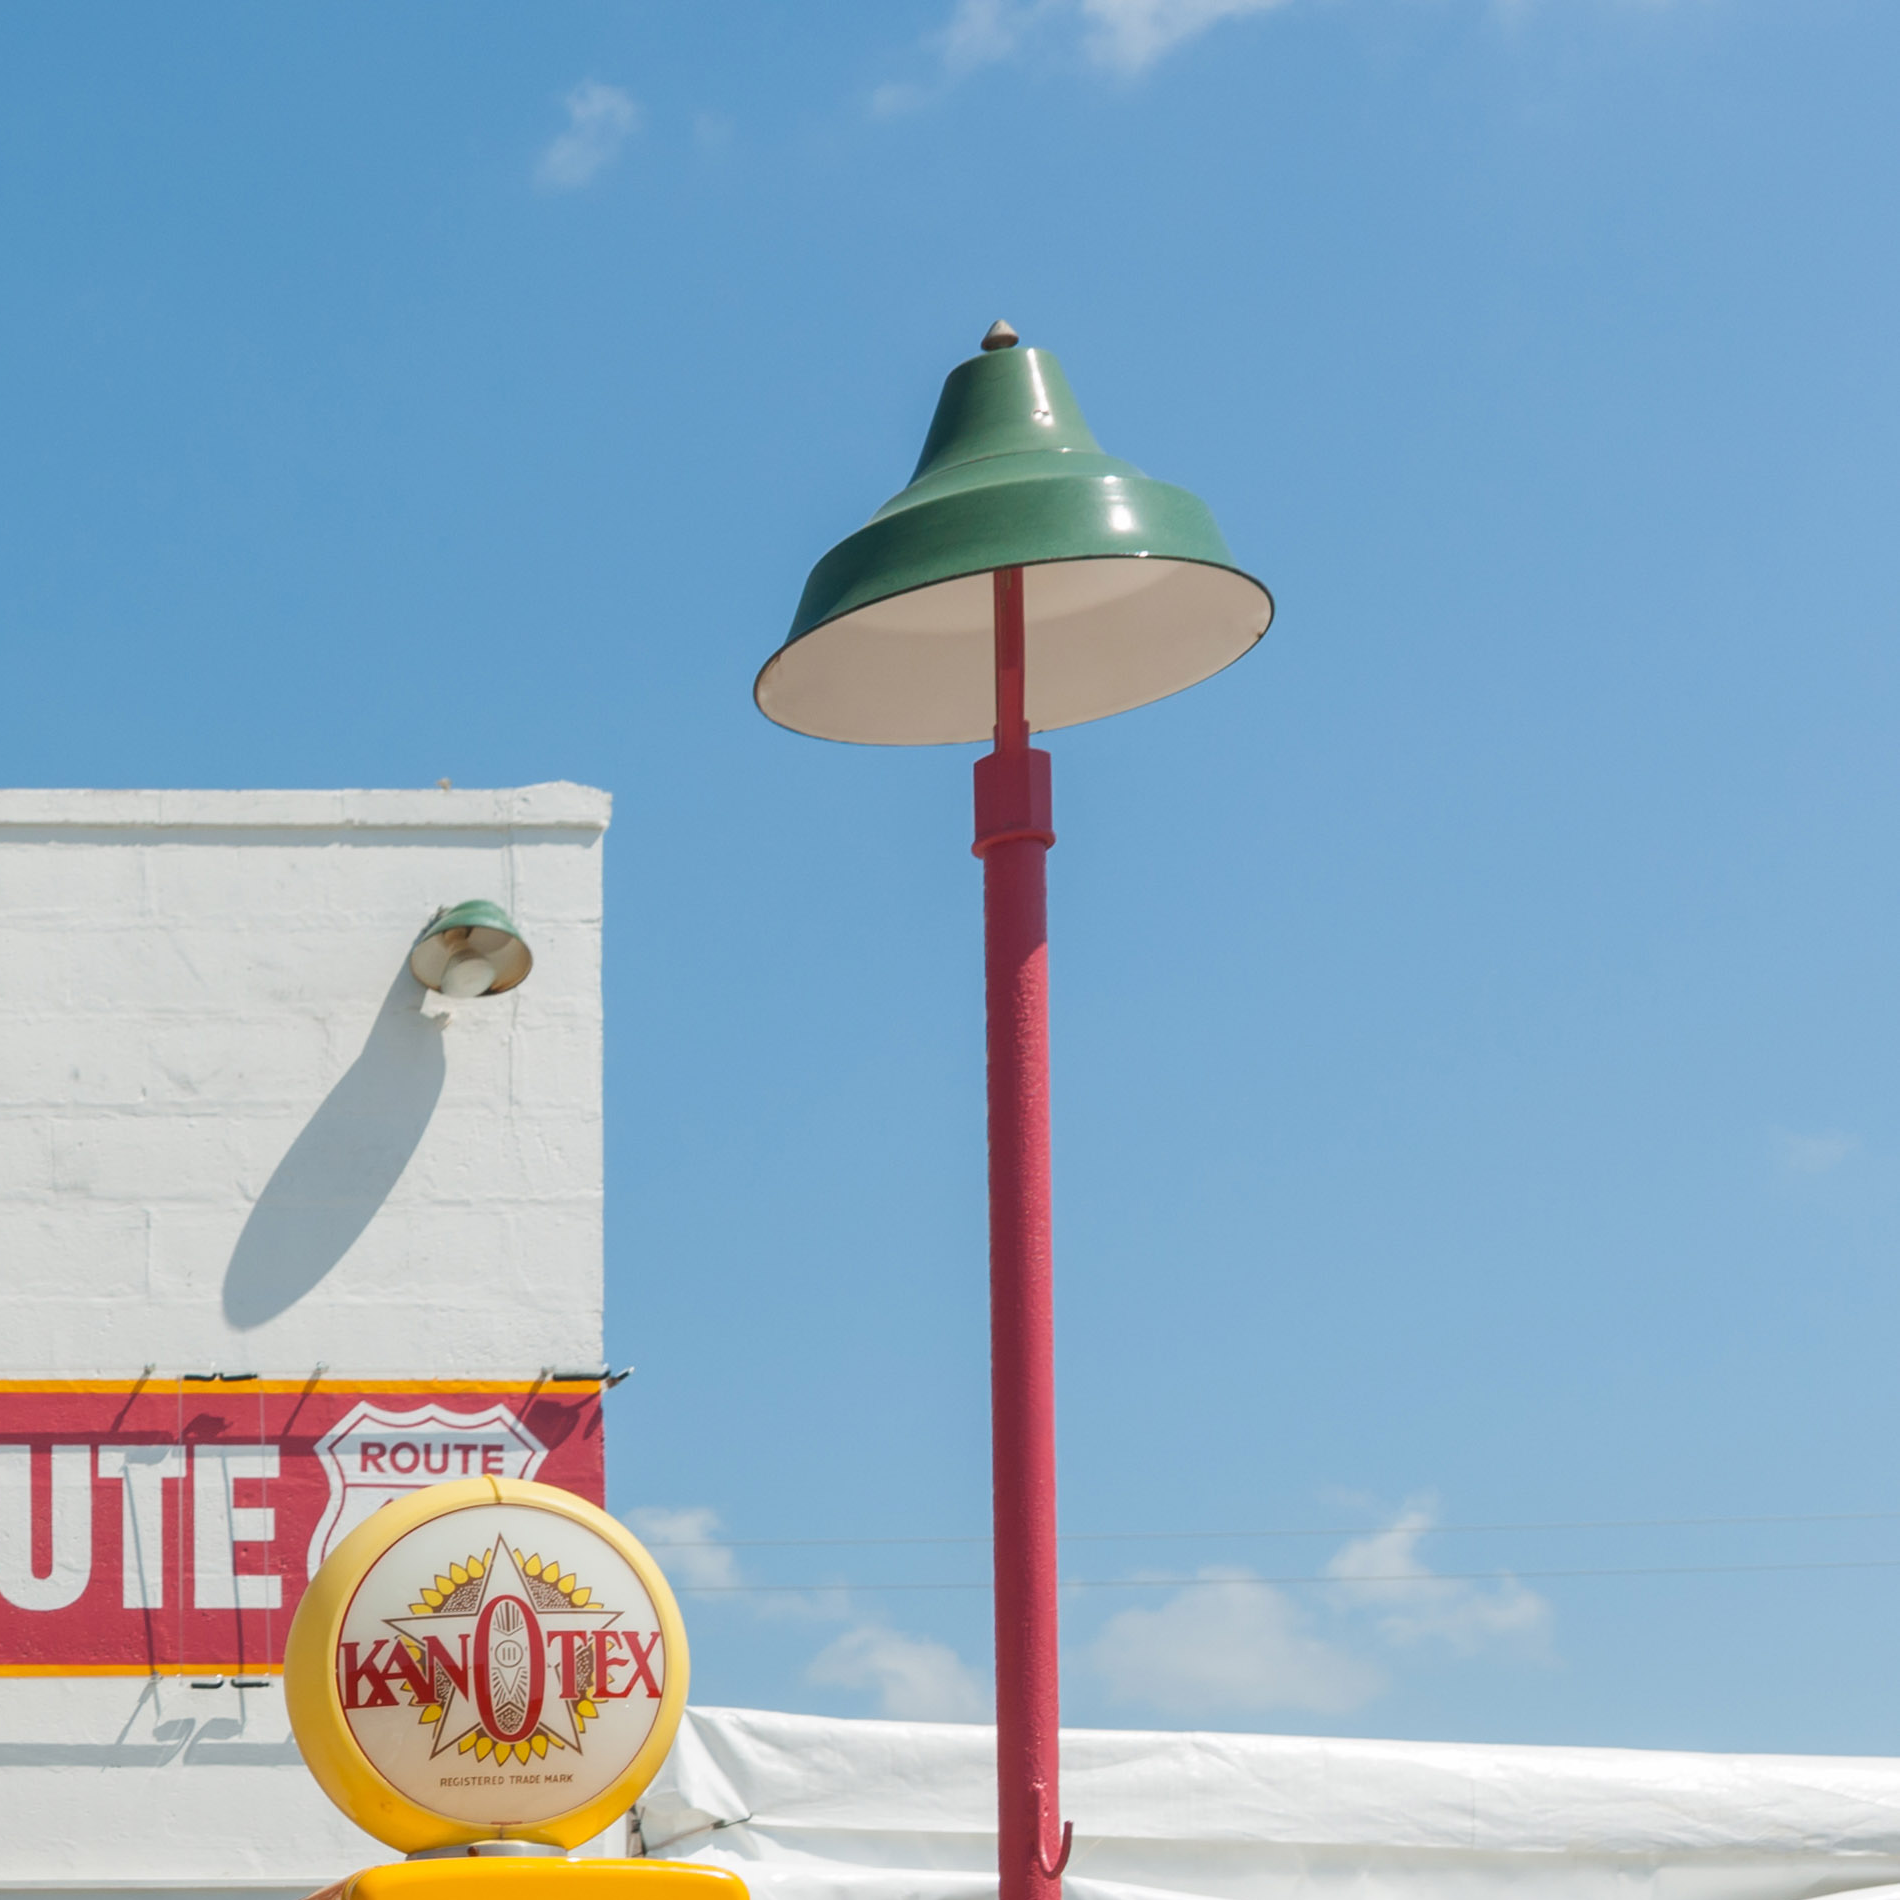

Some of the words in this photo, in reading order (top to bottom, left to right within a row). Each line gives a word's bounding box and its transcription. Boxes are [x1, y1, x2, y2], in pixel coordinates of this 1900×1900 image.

[360, 1441, 505, 1475] ROUTE
[440, 1775, 505, 1788] REGISTERED
[509, 1774, 541, 1786] TRADE
[544, 1773, 574, 1784] MARK
